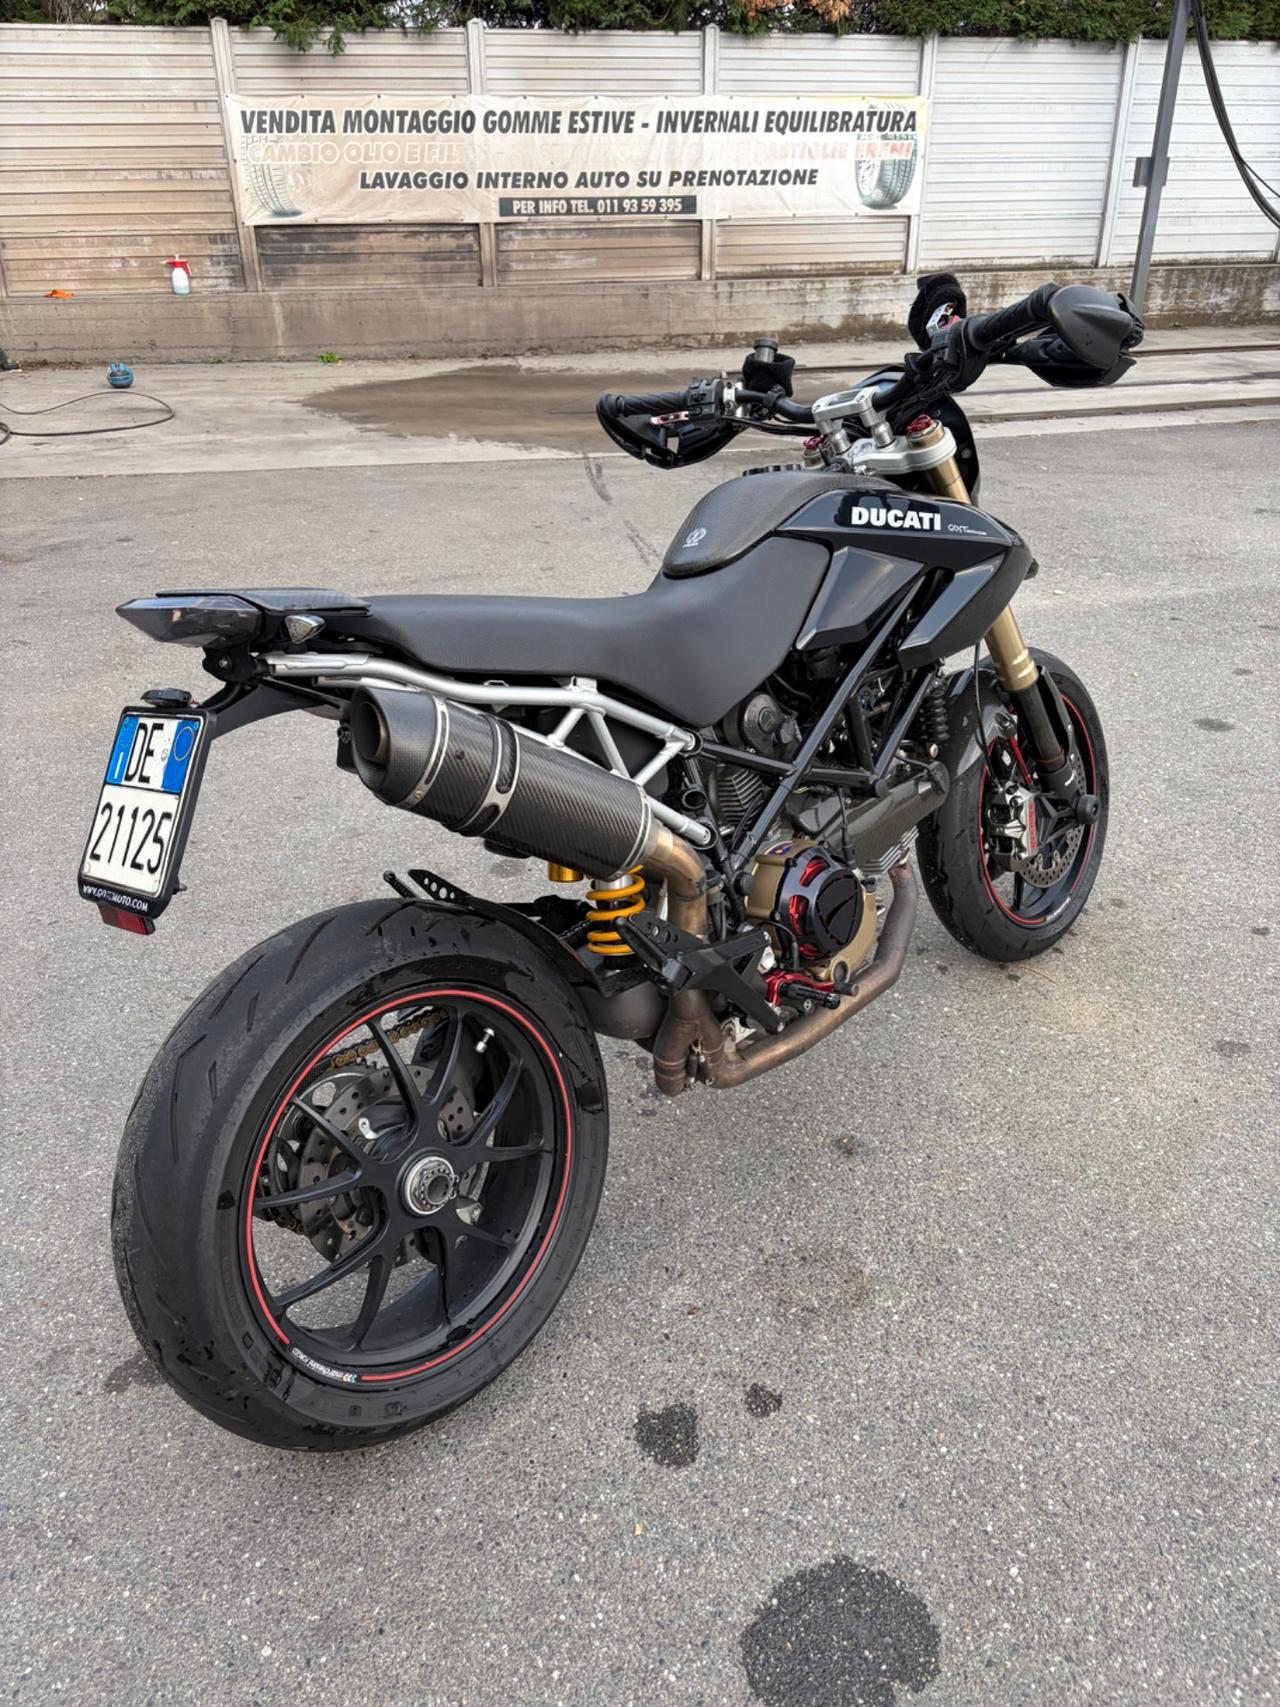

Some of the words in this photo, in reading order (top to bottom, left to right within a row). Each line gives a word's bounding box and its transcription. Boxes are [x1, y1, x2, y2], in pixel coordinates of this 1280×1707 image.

[241, 109, 336, 134] VENDITA
[342, 109, 476, 134] MONTAGGIO
[483, 110, 561, 134] GOMME
[568, 110, 636, 134] ESTIVE
[656, 110, 759, 134] INVERNALI
[764, 110, 917, 135] EQUILIBRATURA
[248, 141, 339, 164] CAMBIO
[343, 141, 401, 164] OLIO
[404, 142, 421, 164] E
[360, 171, 469, 190] LAVAGGIO
[476, 171, 569, 190] INTERNO
[575, 170, 630, 189] AUTO
[636, 170, 662, 188] SU
[668, 168, 819, 187] PRENOTAZIONE
[512, 200, 536, 214] PER
[539, 200, 567, 214] INFO
[570, 200, 594, 214] TEL.
[597, 199, 619, 213] 011
[623, 199, 638, 213] 93
[641, 199, 656, 213] 59
[659, 198, 683, 213] 395
[851, 506, 941, 531] DUCATI
[124, 722, 164, 783] DE
[89, 801, 173, 875] 21125
